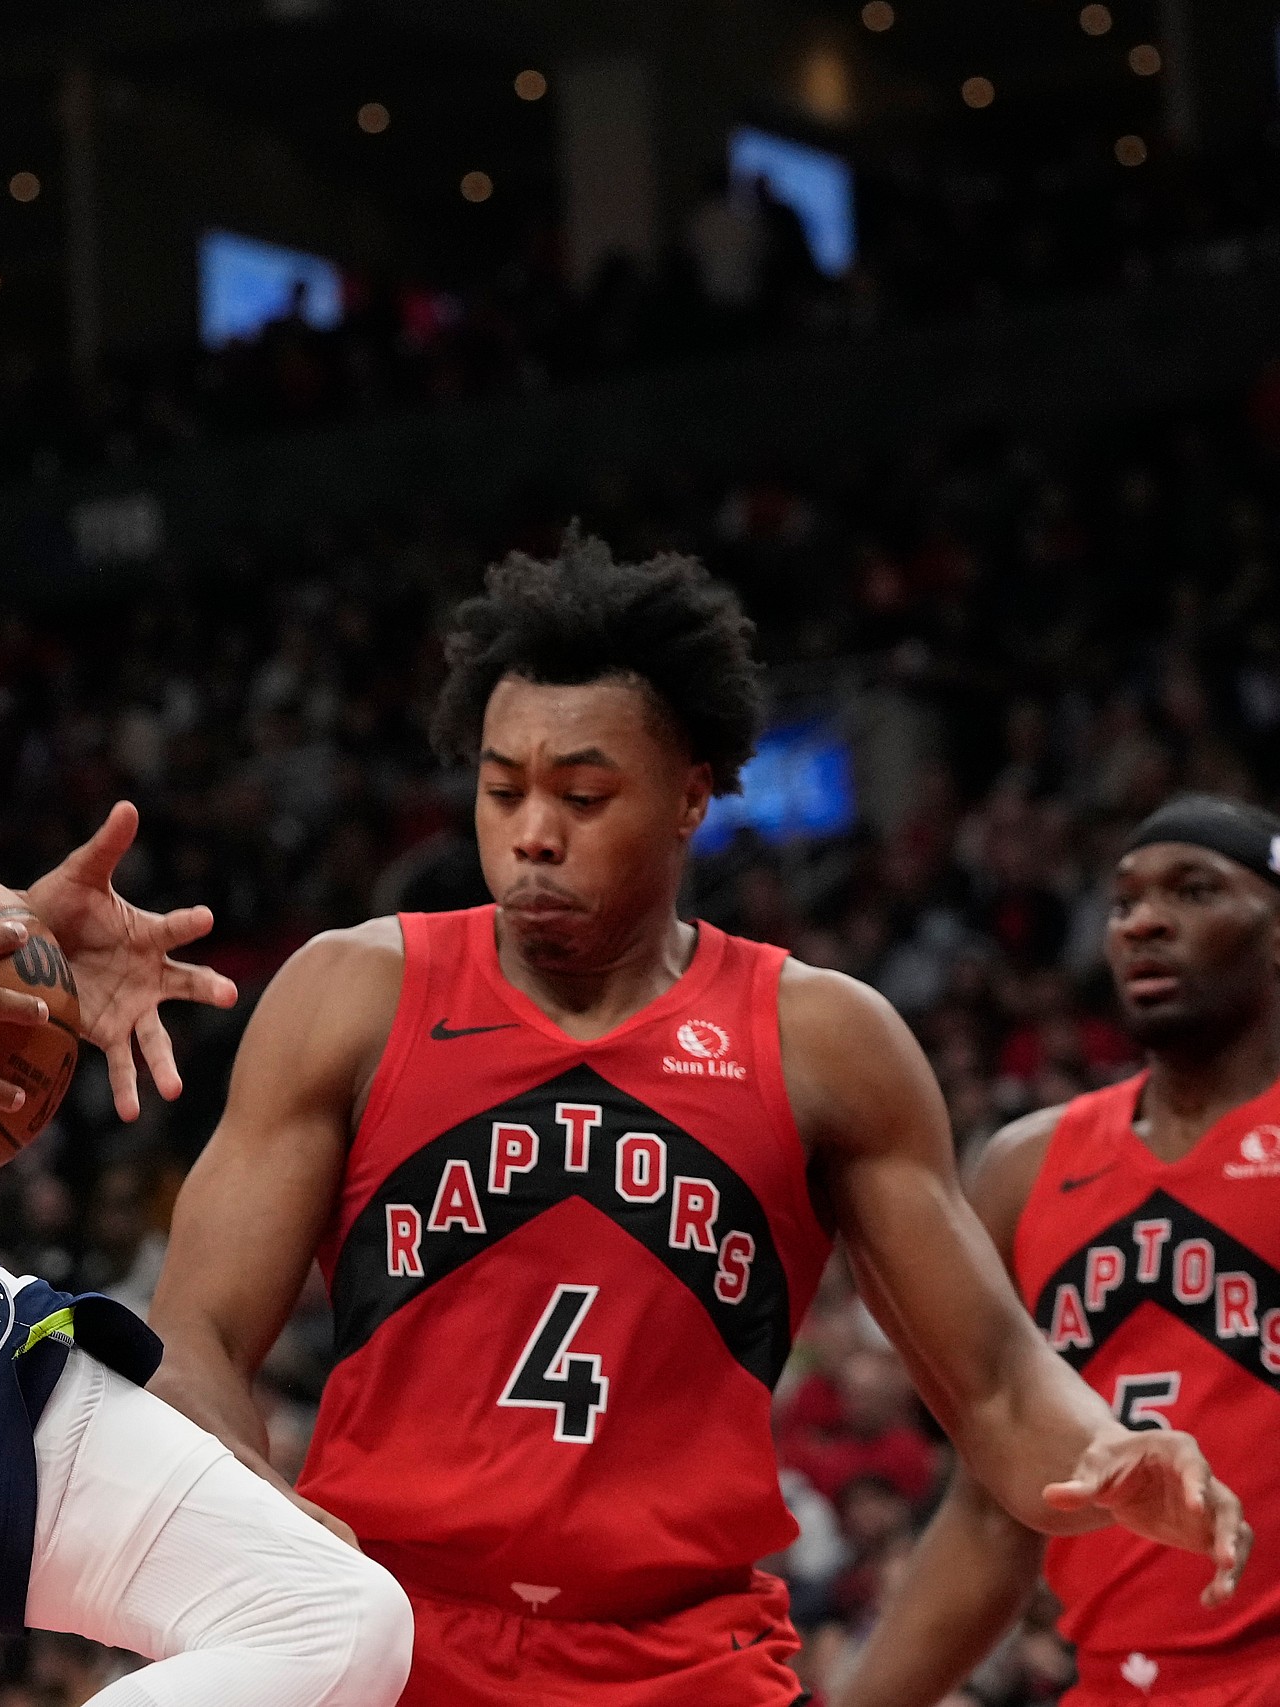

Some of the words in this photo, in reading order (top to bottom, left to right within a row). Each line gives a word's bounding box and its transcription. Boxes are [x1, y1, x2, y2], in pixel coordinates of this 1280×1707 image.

[663, 1055, 704, 1075] Sun
[708, 1060, 746, 1080] Life
[385, 1102, 755, 1305] RAPTORS
[497, 1283, 609, 1444] 4
[1039, 1217, 1280, 1374] APTORS
